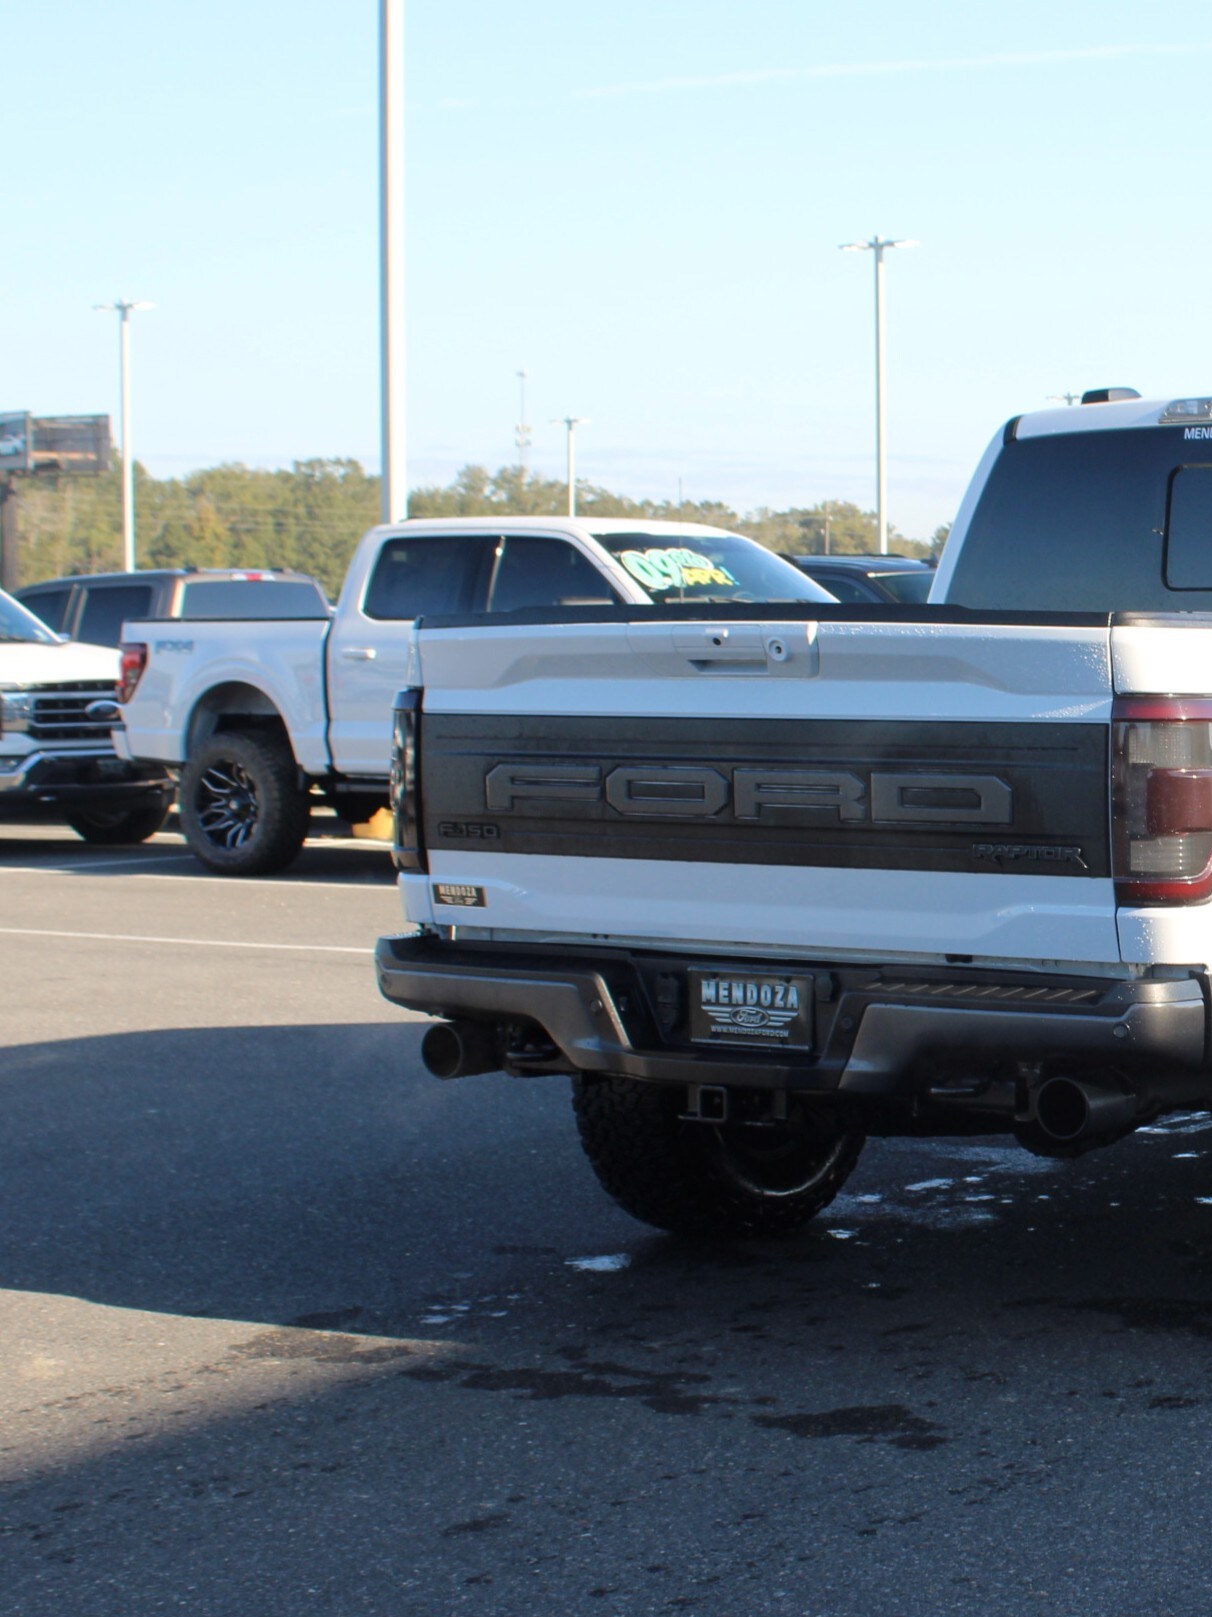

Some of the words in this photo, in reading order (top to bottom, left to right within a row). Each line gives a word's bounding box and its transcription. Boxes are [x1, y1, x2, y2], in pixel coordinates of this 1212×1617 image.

[485, 763, 1014, 825] FORD
[973, 844, 1088, 868] RAPTOR
[438, 884, 477, 897] MENDOZA
[701, 980, 799, 1009] MENDOZA
[737, 1009, 762, 1024] Ford
